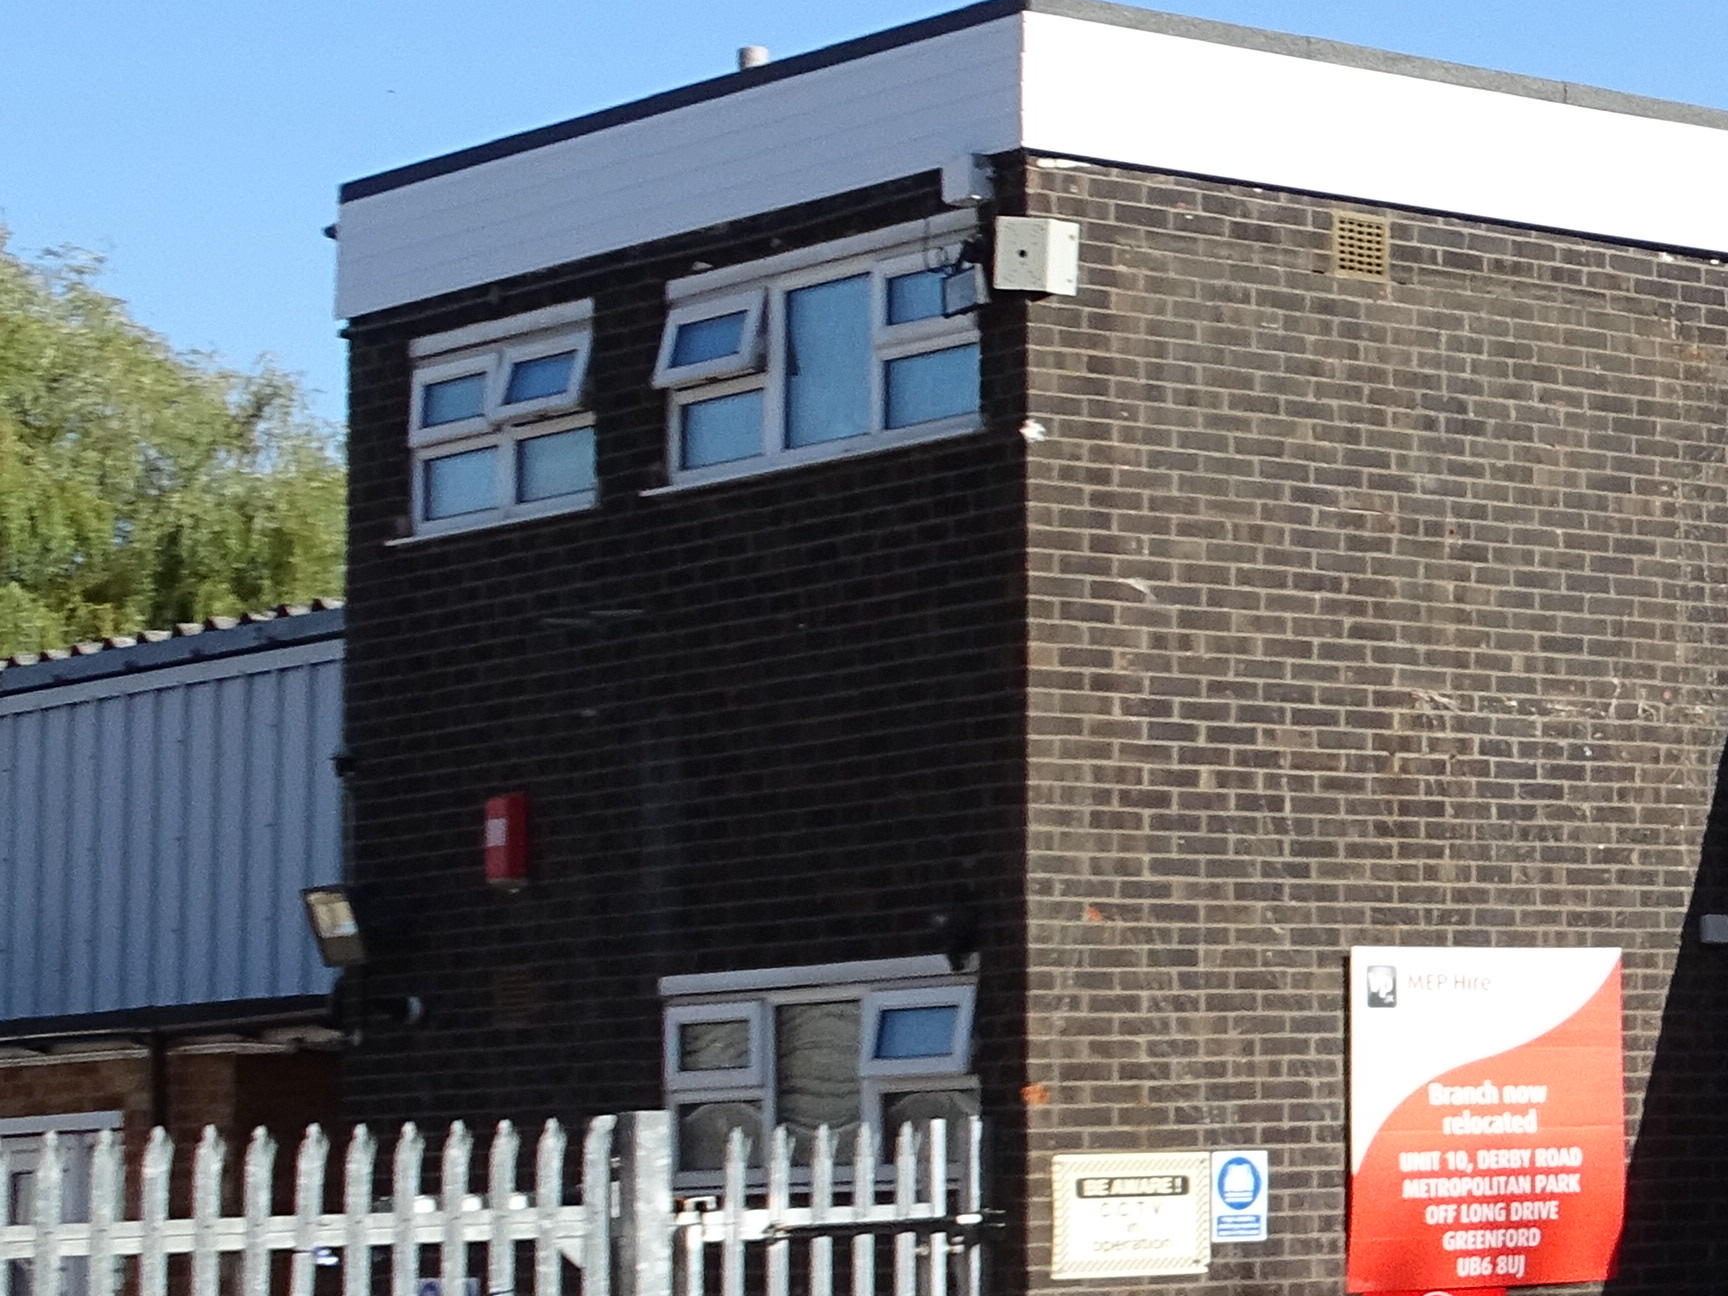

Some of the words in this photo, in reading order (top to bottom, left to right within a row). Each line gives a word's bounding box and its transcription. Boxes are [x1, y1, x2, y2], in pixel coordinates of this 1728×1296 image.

[1408, 974, 1448, 991] MEP
[1453, 974, 1492, 991] Hire
[1428, 1079, 1499, 1106] Branch
[1502, 1085, 1548, 1104] now
[1442, 1108, 1538, 1135] relocated
[1399, 1151, 1441, 1172] UNIT
[1444, 1150, 1474, 1174] 10,
[1476, 1148, 1532, 1169] DERBY
[1535, 1147, 1583, 1167] ROAD
[1402, 1175, 1531, 1198] METROPOLITAN
[1534, 1173, 1581, 1193] PARK
[1425, 1205, 1457, 1225] OFF
[1460, 1203, 1506, 1223] LONG
[1510, 1200, 1559, 1221] DRIVE
[1442, 1227, 1541, 1251] GREENFORD
[1456, 1256, 1492, 1277] UB6
[1495, 1255, 1526, 1279] 8UJ
